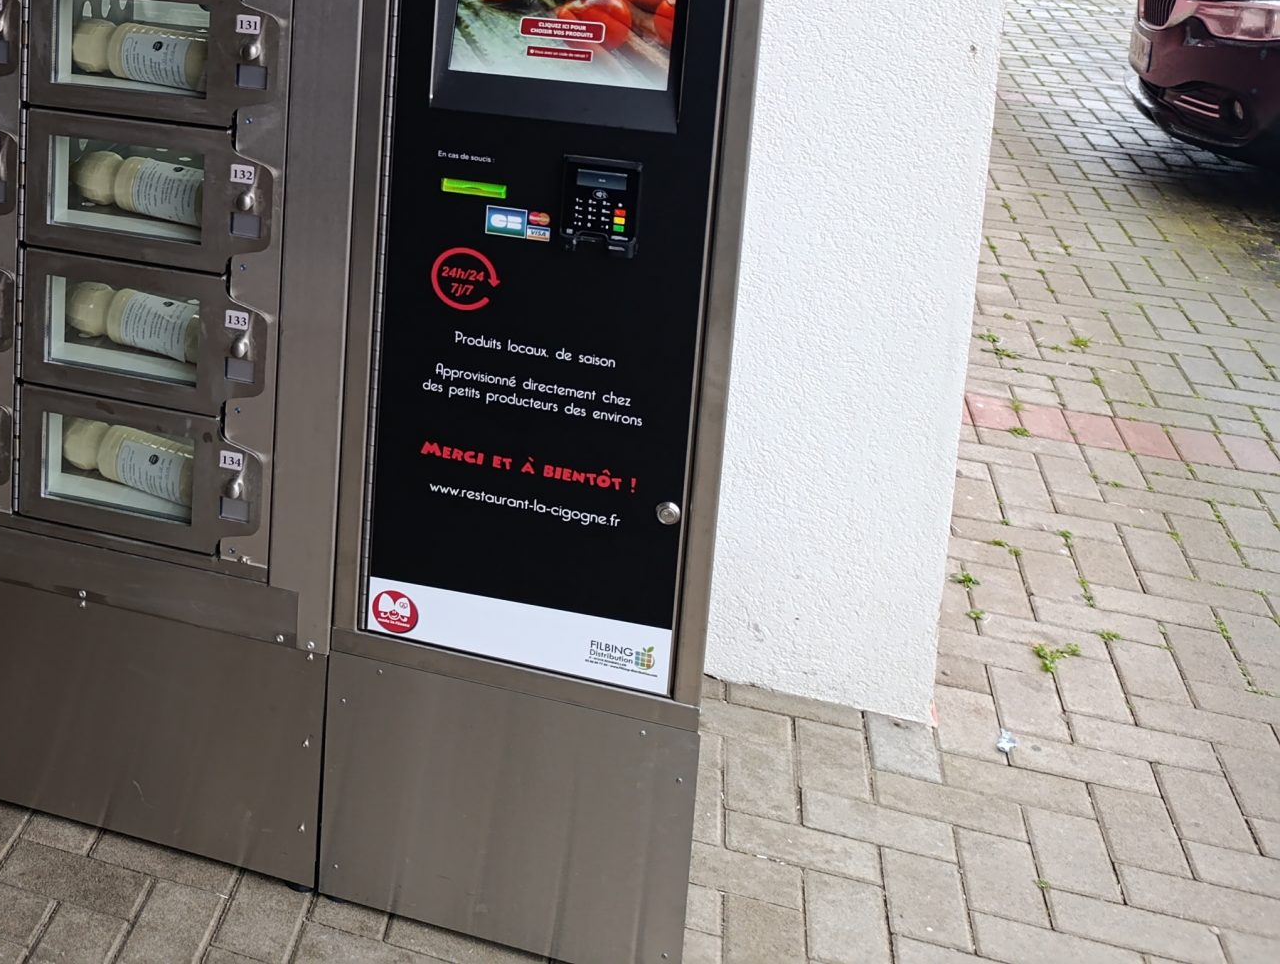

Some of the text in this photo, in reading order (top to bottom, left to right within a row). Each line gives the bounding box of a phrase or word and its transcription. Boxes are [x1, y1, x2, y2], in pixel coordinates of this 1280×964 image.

[238, 19, 258, 31] 131
[566, 30, 594, 38] PRODUITS
[232, 168, 253, 181] 132
[441, 266, 485, 282] 24h/24
[450, 282, 474, 296] 7j/7
[227, 314, 248, 327] 133
[455, 330, 502, 350] Produits
[556, 348, 572, 361] de
[578, 352, 616, 368] saison
[436, 362, 632, 407] Approvisionné directement chez
[422, 379, 643, 427] des petits producteurs des environs
[222, 454, 242, 468] 134
[420, 441, 637, 494] MERCI ET À BIENTÔT !
[429, 482, 621, 528] www.restaurant-la-cigogne.fr
[589, 648, 634, 664] Distribution
[590, 640, 634, 656] FILBING
